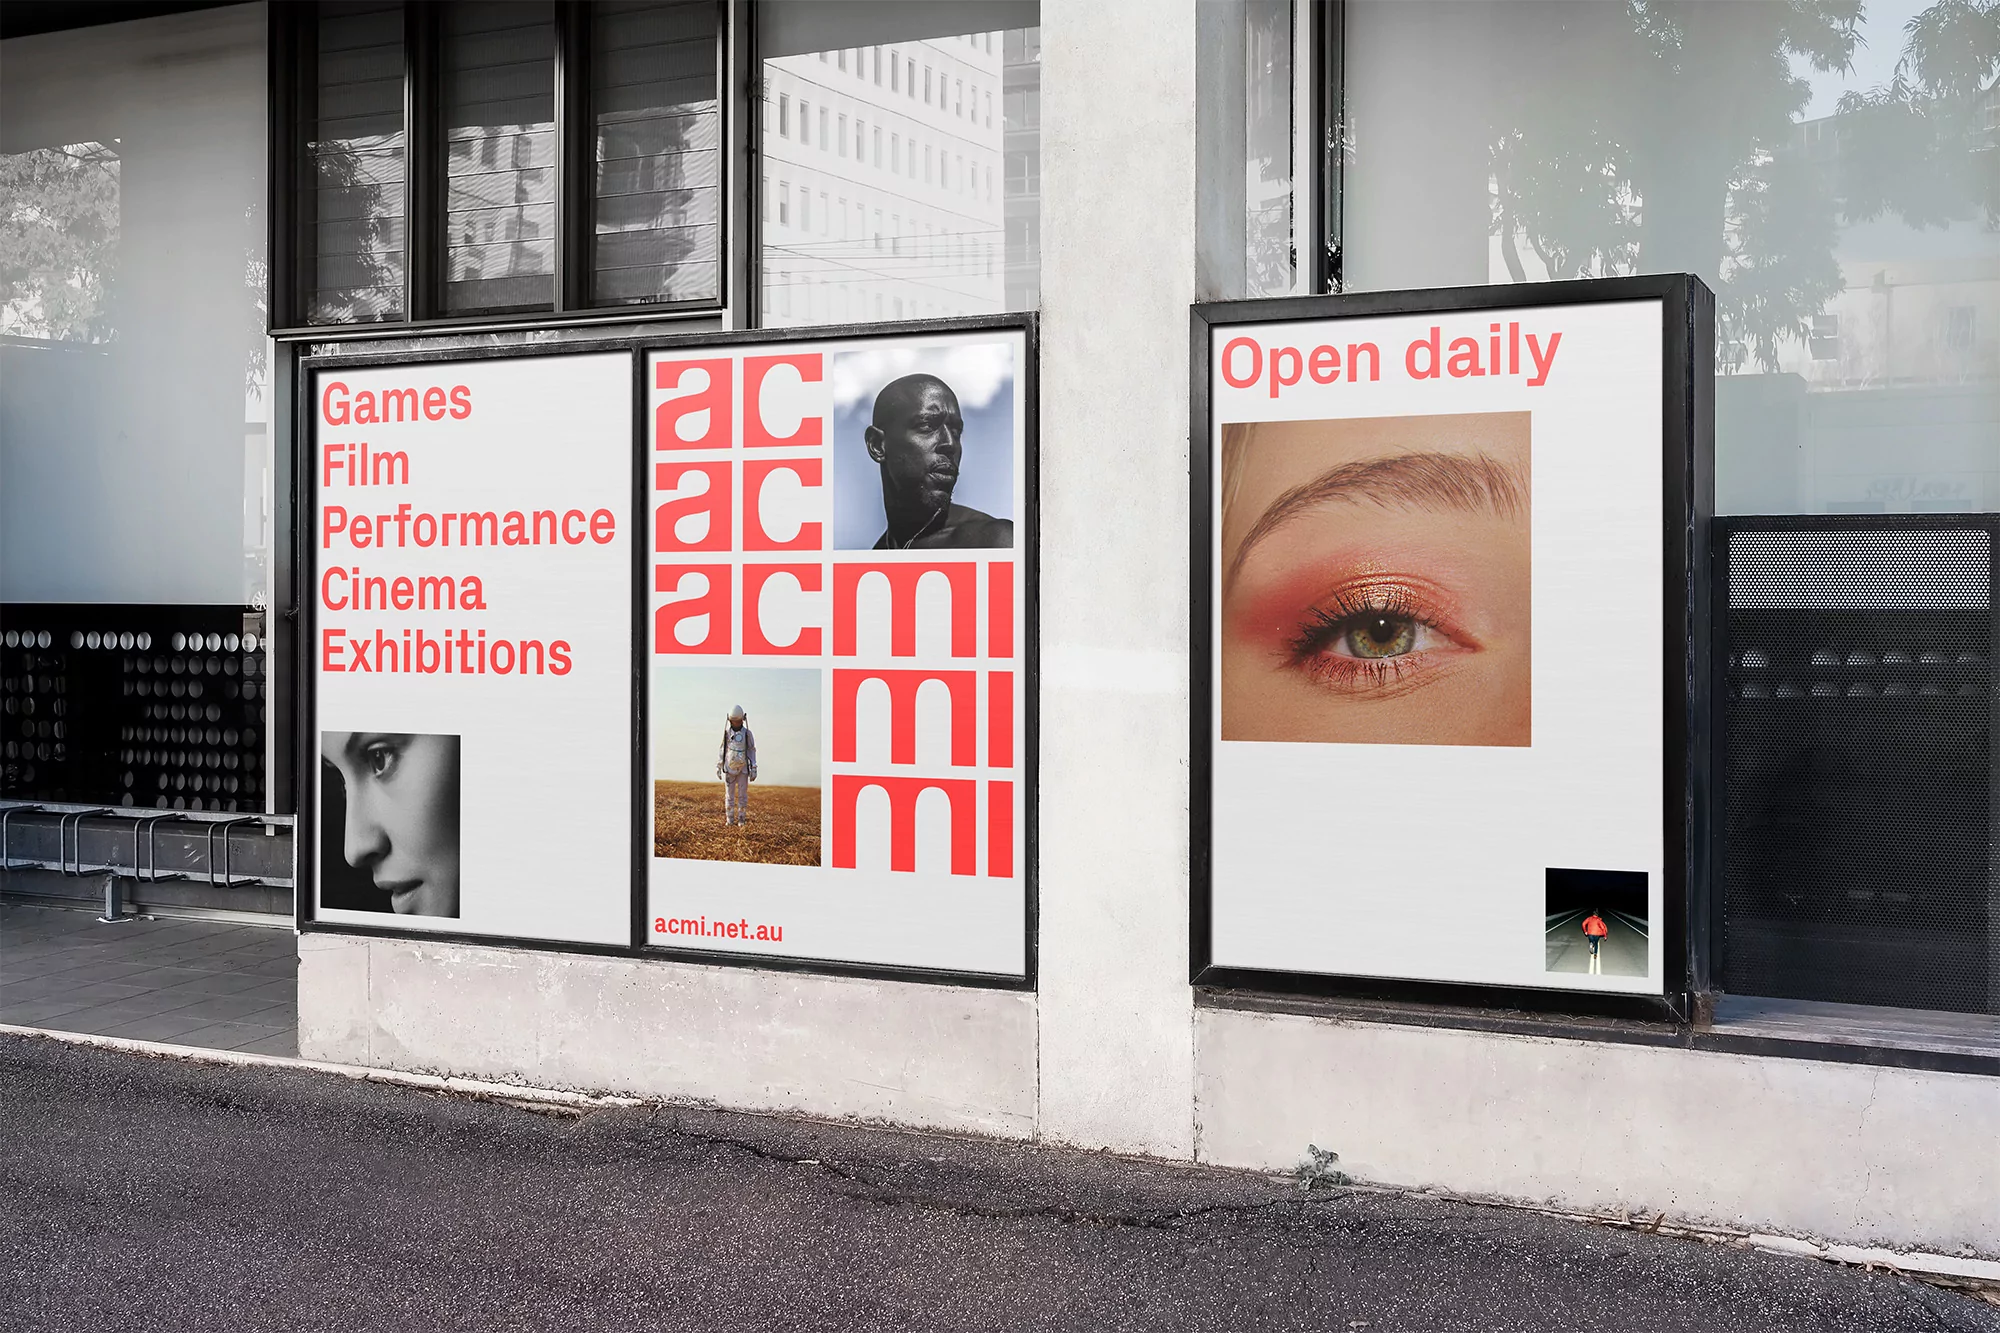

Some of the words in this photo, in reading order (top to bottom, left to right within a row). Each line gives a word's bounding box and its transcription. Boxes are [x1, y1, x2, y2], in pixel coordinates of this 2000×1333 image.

[1221, 336, 1381, 399] Open
[1404, 321, 1563, 387] daily
[322, 381, 472, 426] Games
[655, 352, 823, 451] ac
[323, 442, 409, 487] Film
[323, 503, 616, 549] Performance
[655, 457, 823, 553] ac
[321, 565, 487, 611] Cinema
[654, 561, 1015, 659] acmi
[322, 628, 573, 677] Exhibitions
[654, 915, 783, 943] acmi.net.au
